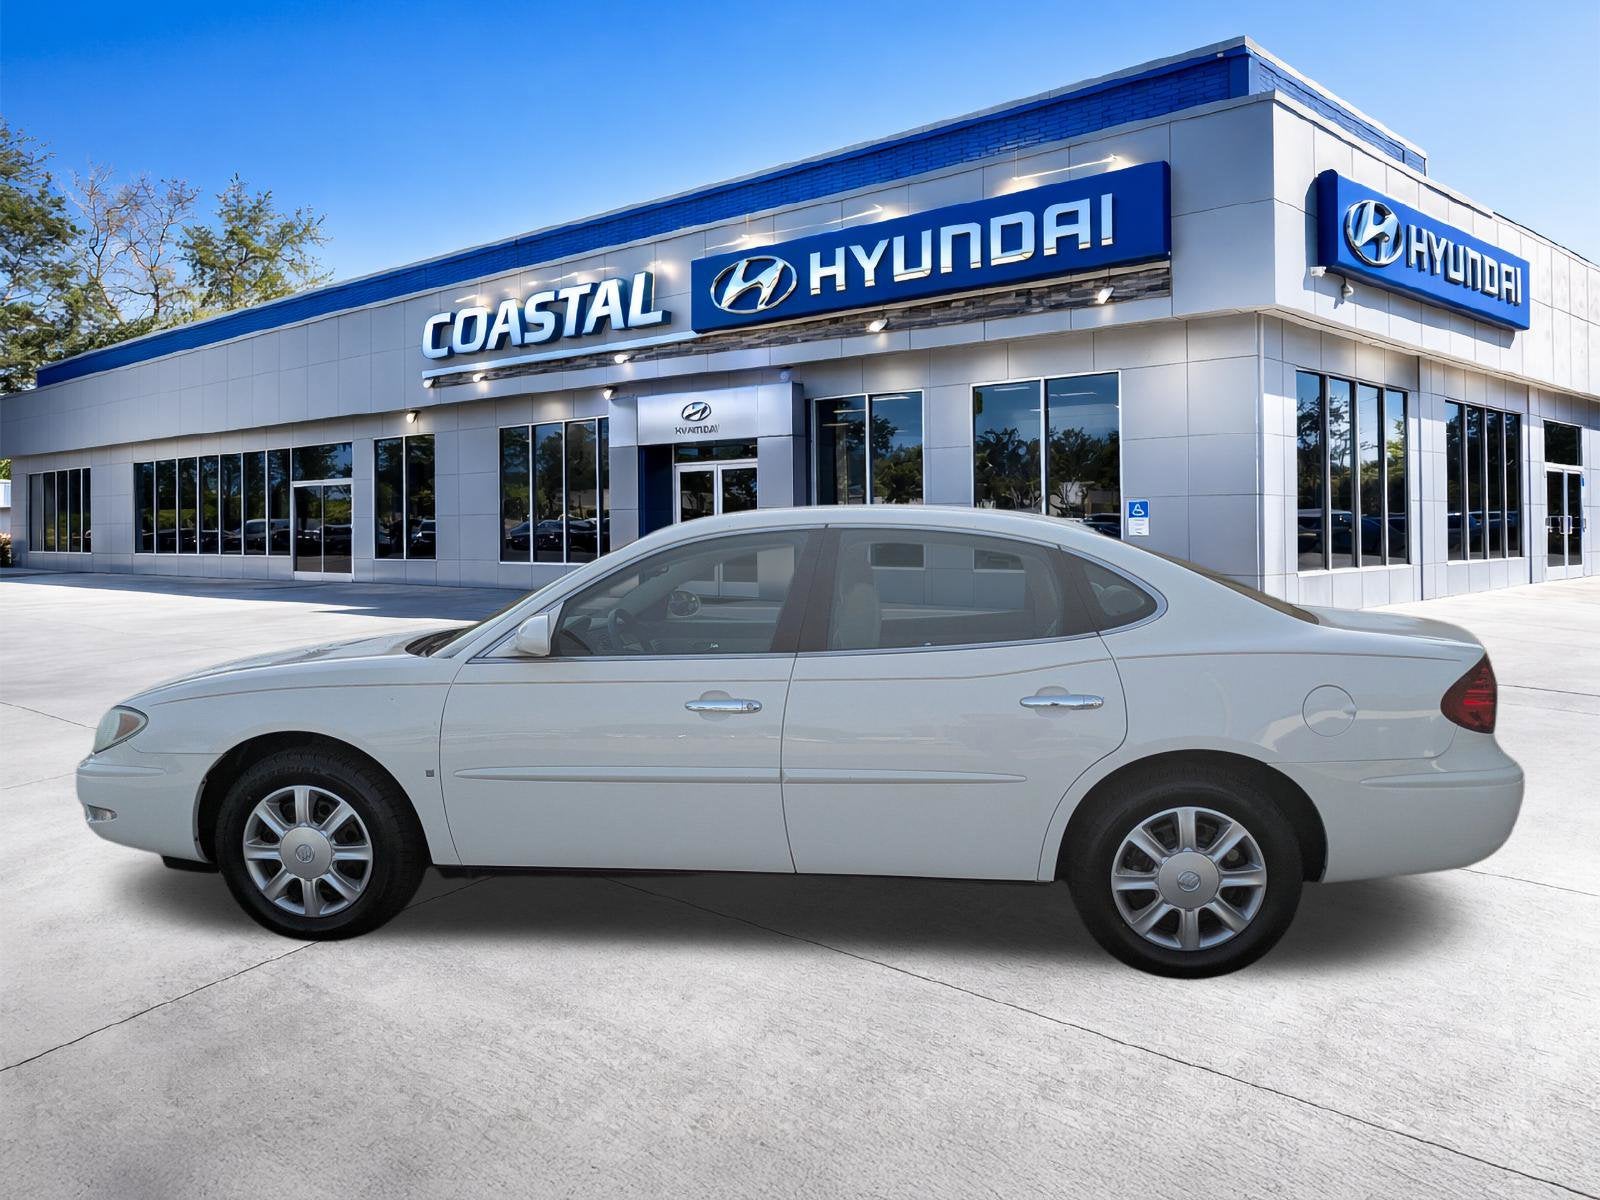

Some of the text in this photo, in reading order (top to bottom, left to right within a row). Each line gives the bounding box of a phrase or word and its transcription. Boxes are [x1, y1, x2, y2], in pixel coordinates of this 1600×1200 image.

[809, 193, 1114, 296] HYUNDAI
[1406, 224, 1522, 306] HYUNDAI
[421, 271, 671, 359] COASTAL
